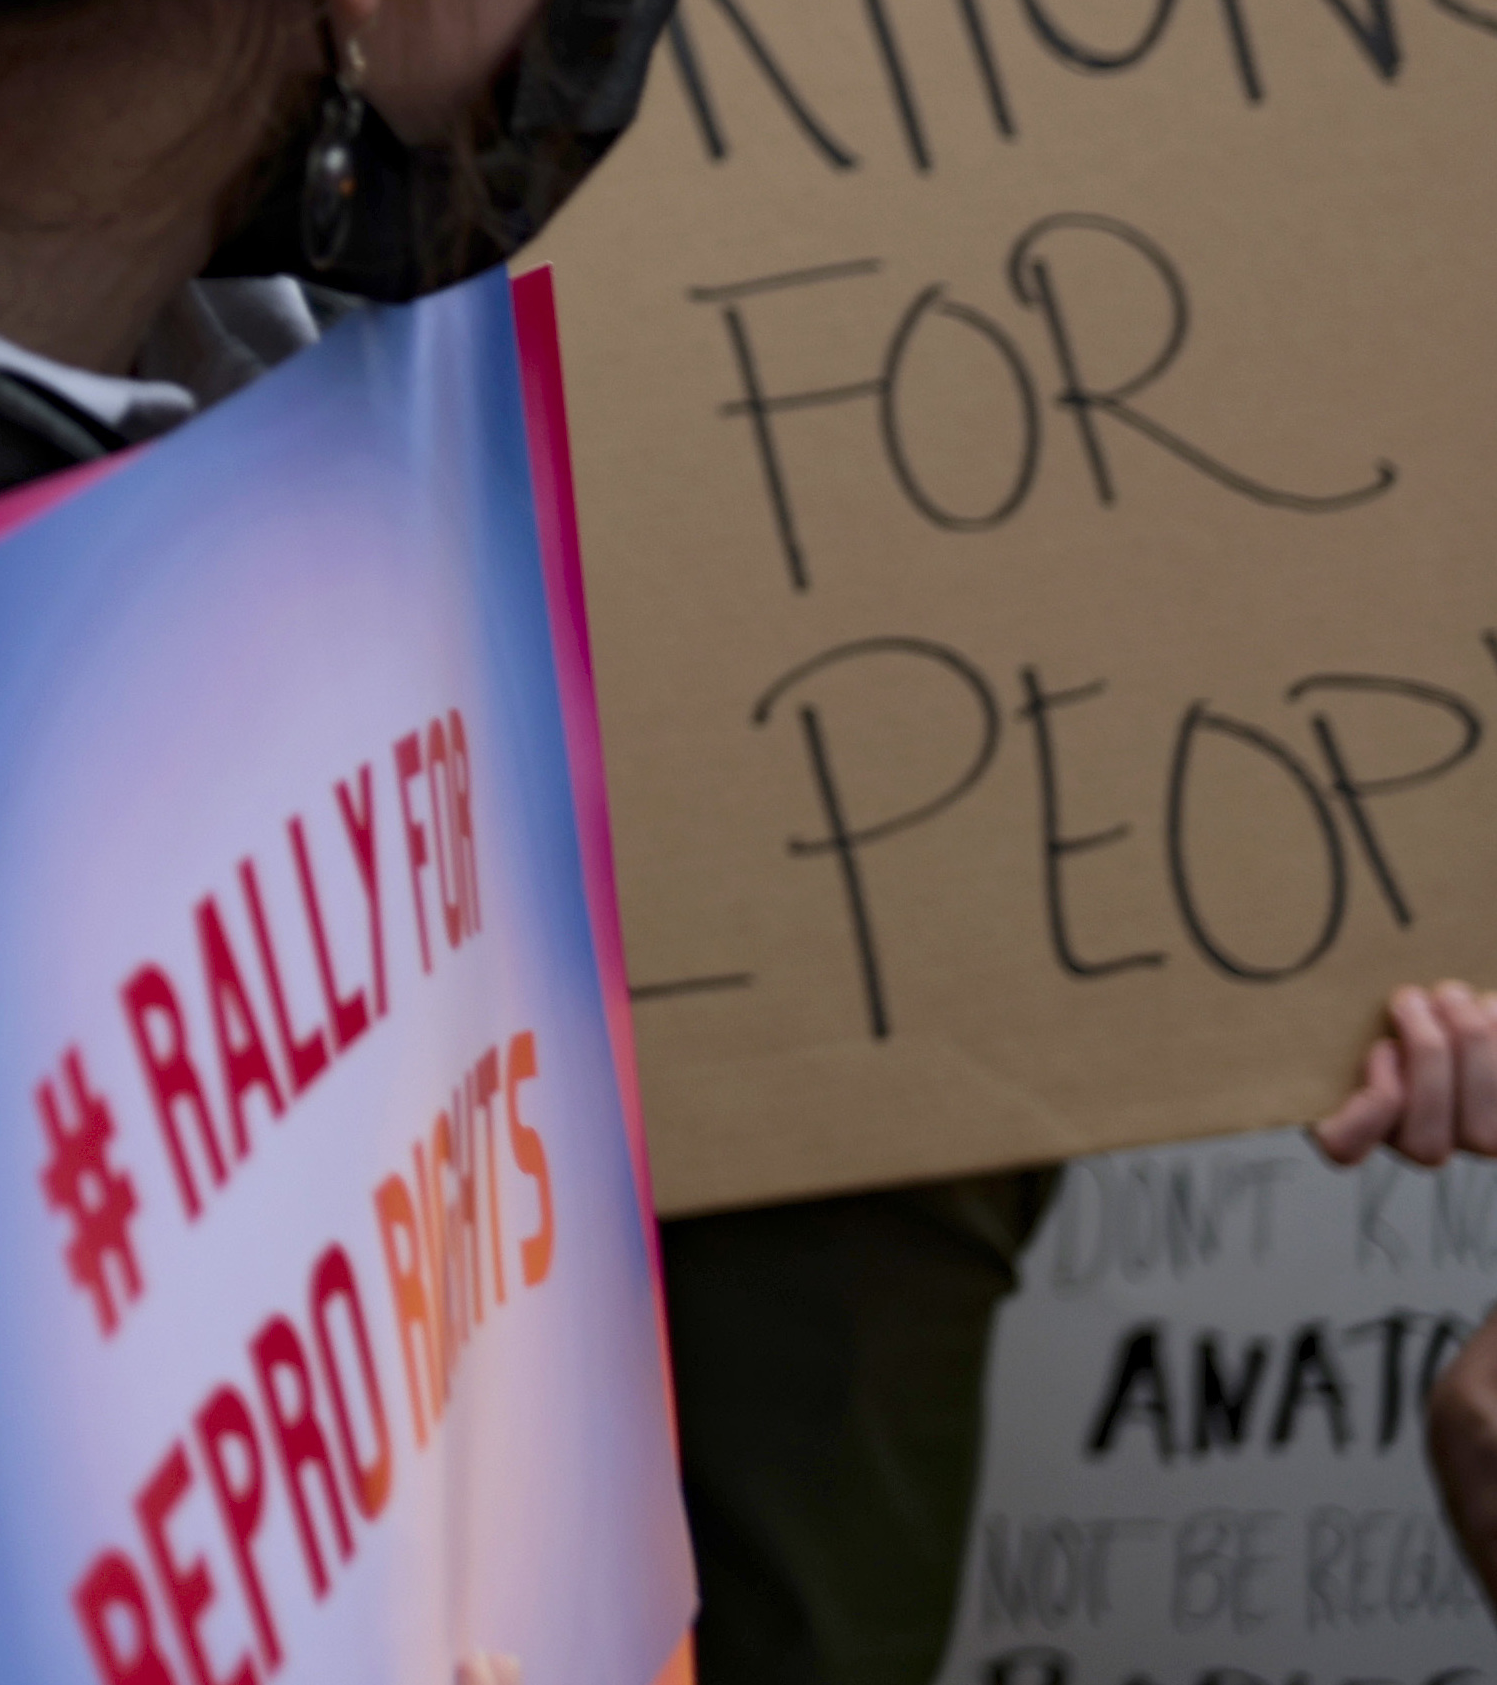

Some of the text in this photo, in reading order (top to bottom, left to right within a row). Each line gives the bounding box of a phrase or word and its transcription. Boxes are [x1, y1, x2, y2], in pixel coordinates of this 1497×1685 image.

[686, 211, 1398, 594] FOR
[392, 706, 485, 978] FOR
[750, 631, 1497, 1042] PEOP
[68, 1029, 557, 1685] REPRO RIGHTS
